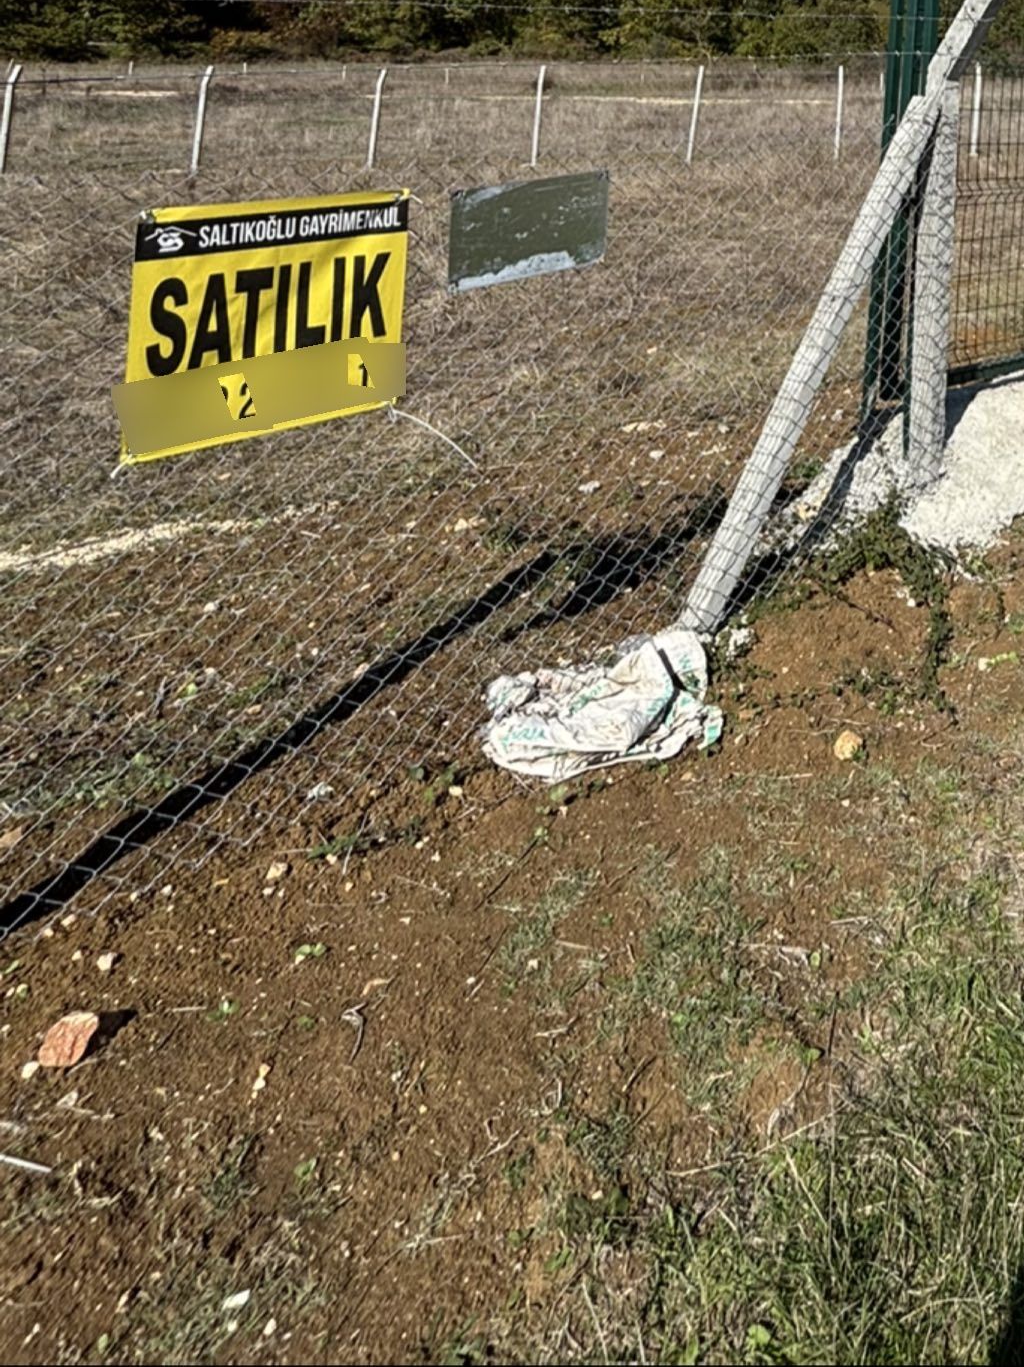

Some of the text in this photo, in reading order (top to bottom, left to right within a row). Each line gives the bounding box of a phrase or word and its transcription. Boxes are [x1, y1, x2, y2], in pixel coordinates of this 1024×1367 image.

[199, 206, 401, 248] SALTIKOĞLU GAYRİMENKUL
[146, 252, 392, 377] SATILIK
